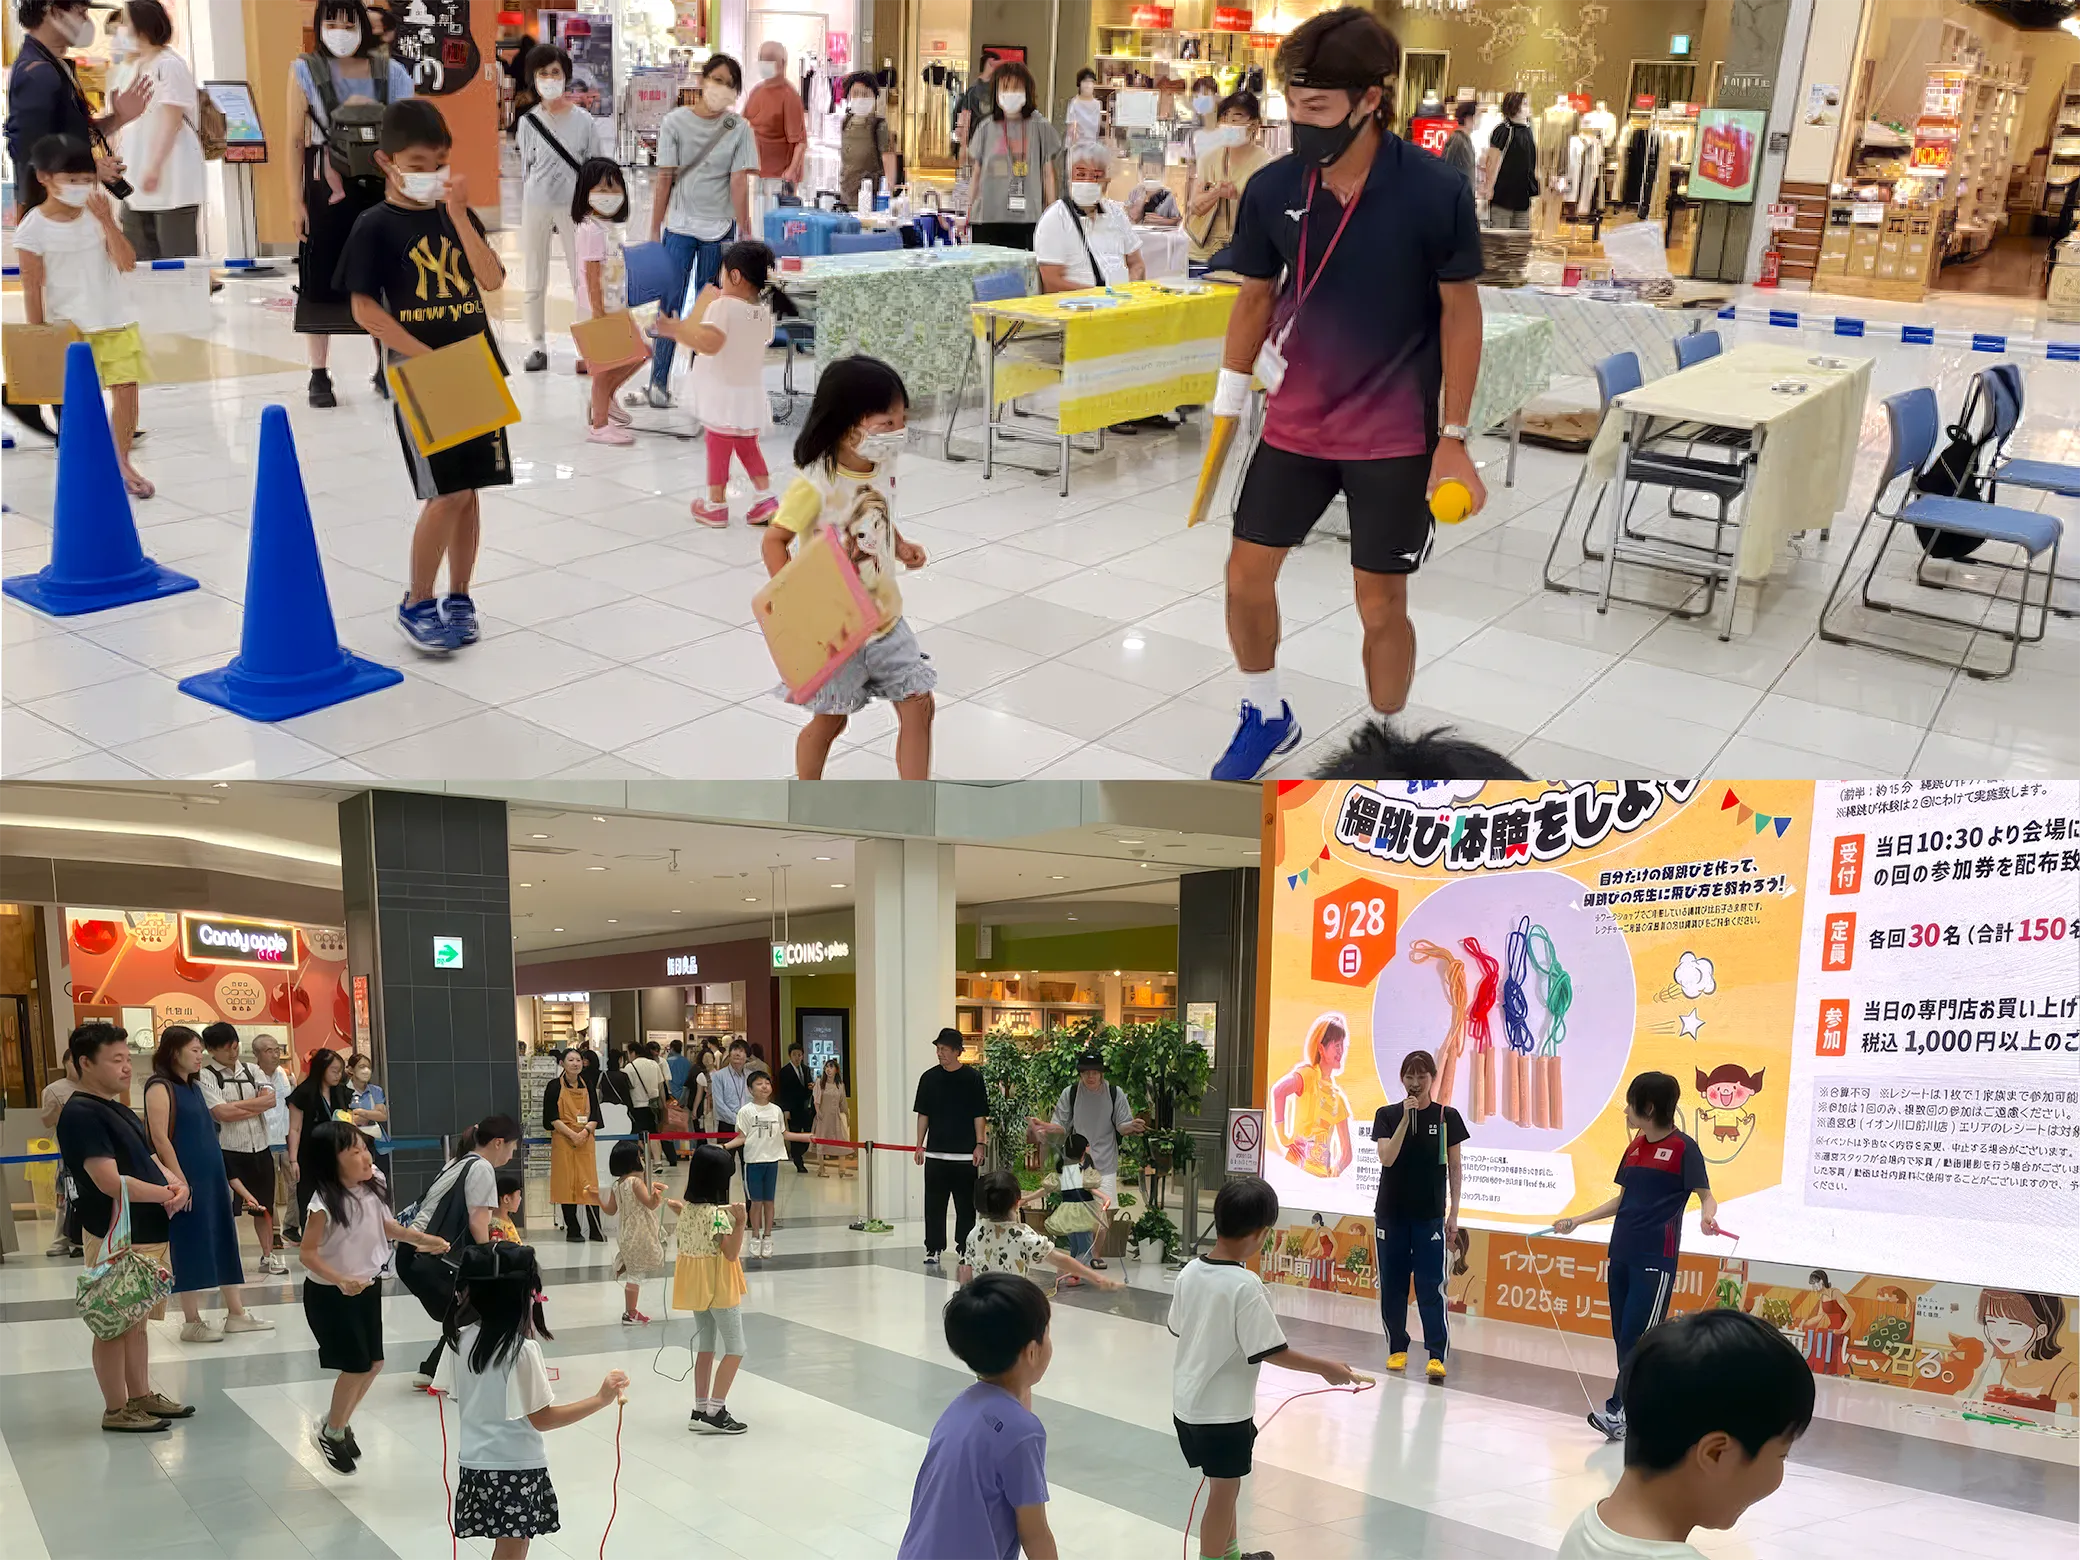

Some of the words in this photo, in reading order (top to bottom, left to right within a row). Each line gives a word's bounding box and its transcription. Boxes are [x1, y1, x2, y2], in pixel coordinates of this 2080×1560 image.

[408, 234, 471, 301] NY
[1876, 817, 2079, 858] 当日10:30より会場に
[1837, 841, 1858, 889] 受付
[1873, 848, 2079, 887] の回の参加券を配布致
[199, 924, 250, 952] Candy
[250, 932, 288, 953] apple
[1322, 897, 1387, 941] 9/28
[1342, 948, 1358, 974] 日
[1828, 919, 1850, 965] 定員
[1822, 1007, 1844, 1050] 参加
[1863, 996, 2079, 1022] 当日の専門店お買い上げ
[1812, 1180, 1848, 1191] ください。
[1496, 1283, 1568, 1314] 2025年
